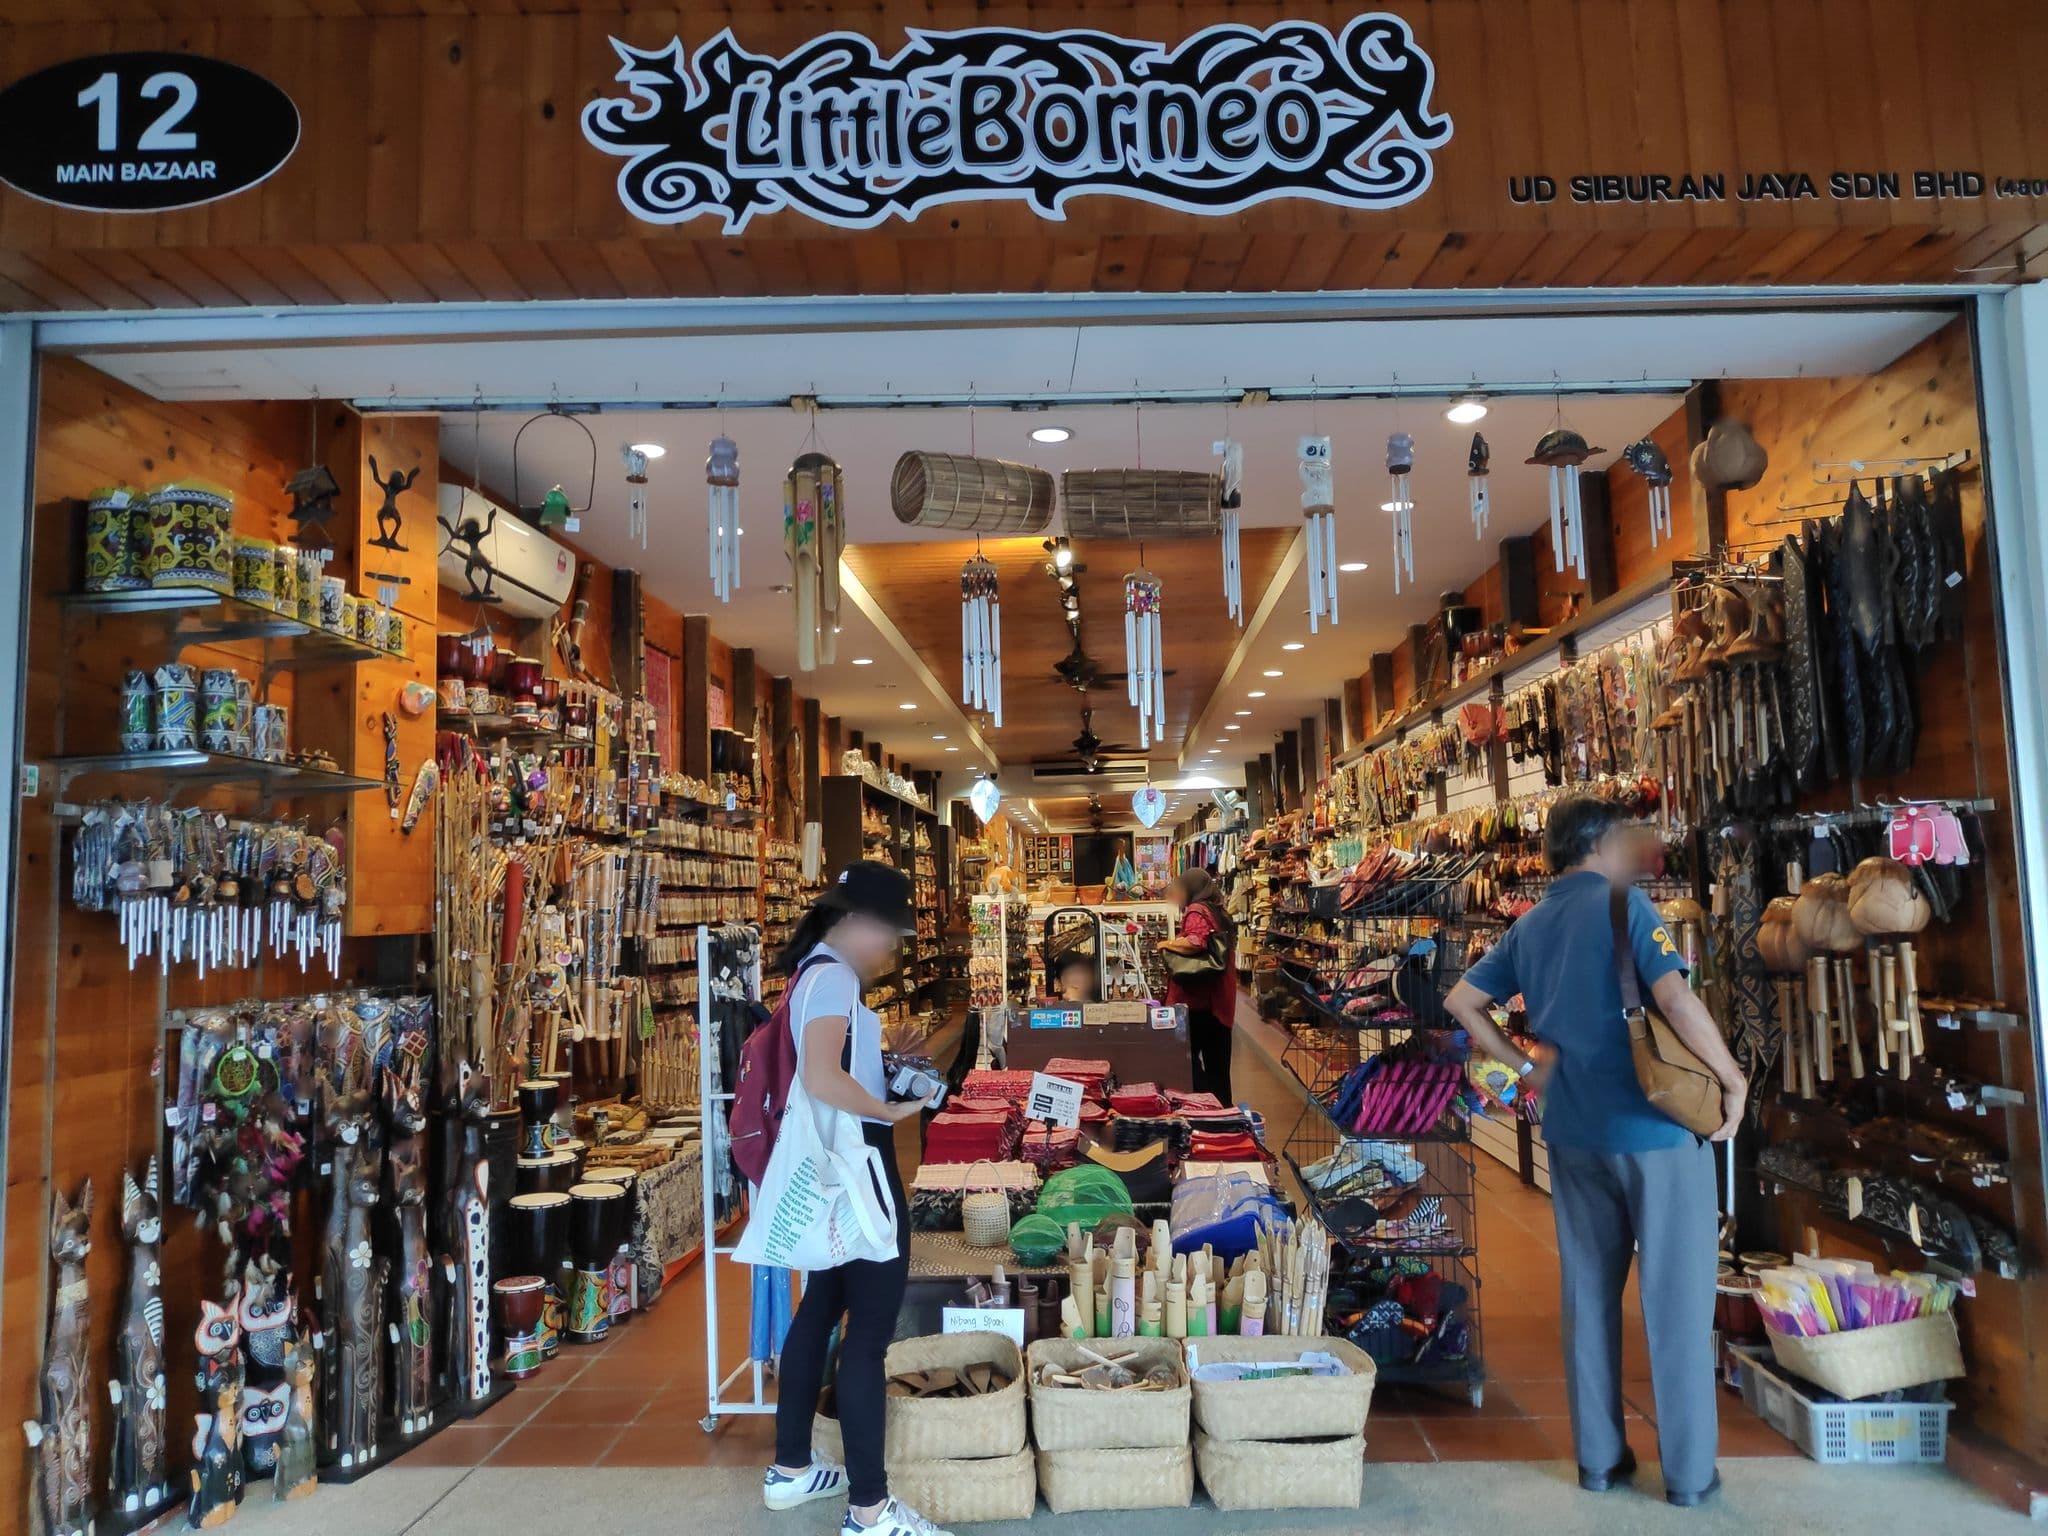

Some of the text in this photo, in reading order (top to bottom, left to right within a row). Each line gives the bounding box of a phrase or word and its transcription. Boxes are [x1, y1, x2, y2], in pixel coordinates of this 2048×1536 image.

[77, 71, 199, 152] 12
[56, 160, 217, 183] MAIN BAZAAR
[1508, 176, 1557, 203] UD
[1569, 174, 1726, 203] SIBURAN
[1735, 173, 1821, 201] JAYA
[1828, 172, 1901, 200] SDN
[1911, 171, 1986, 199] BHD
